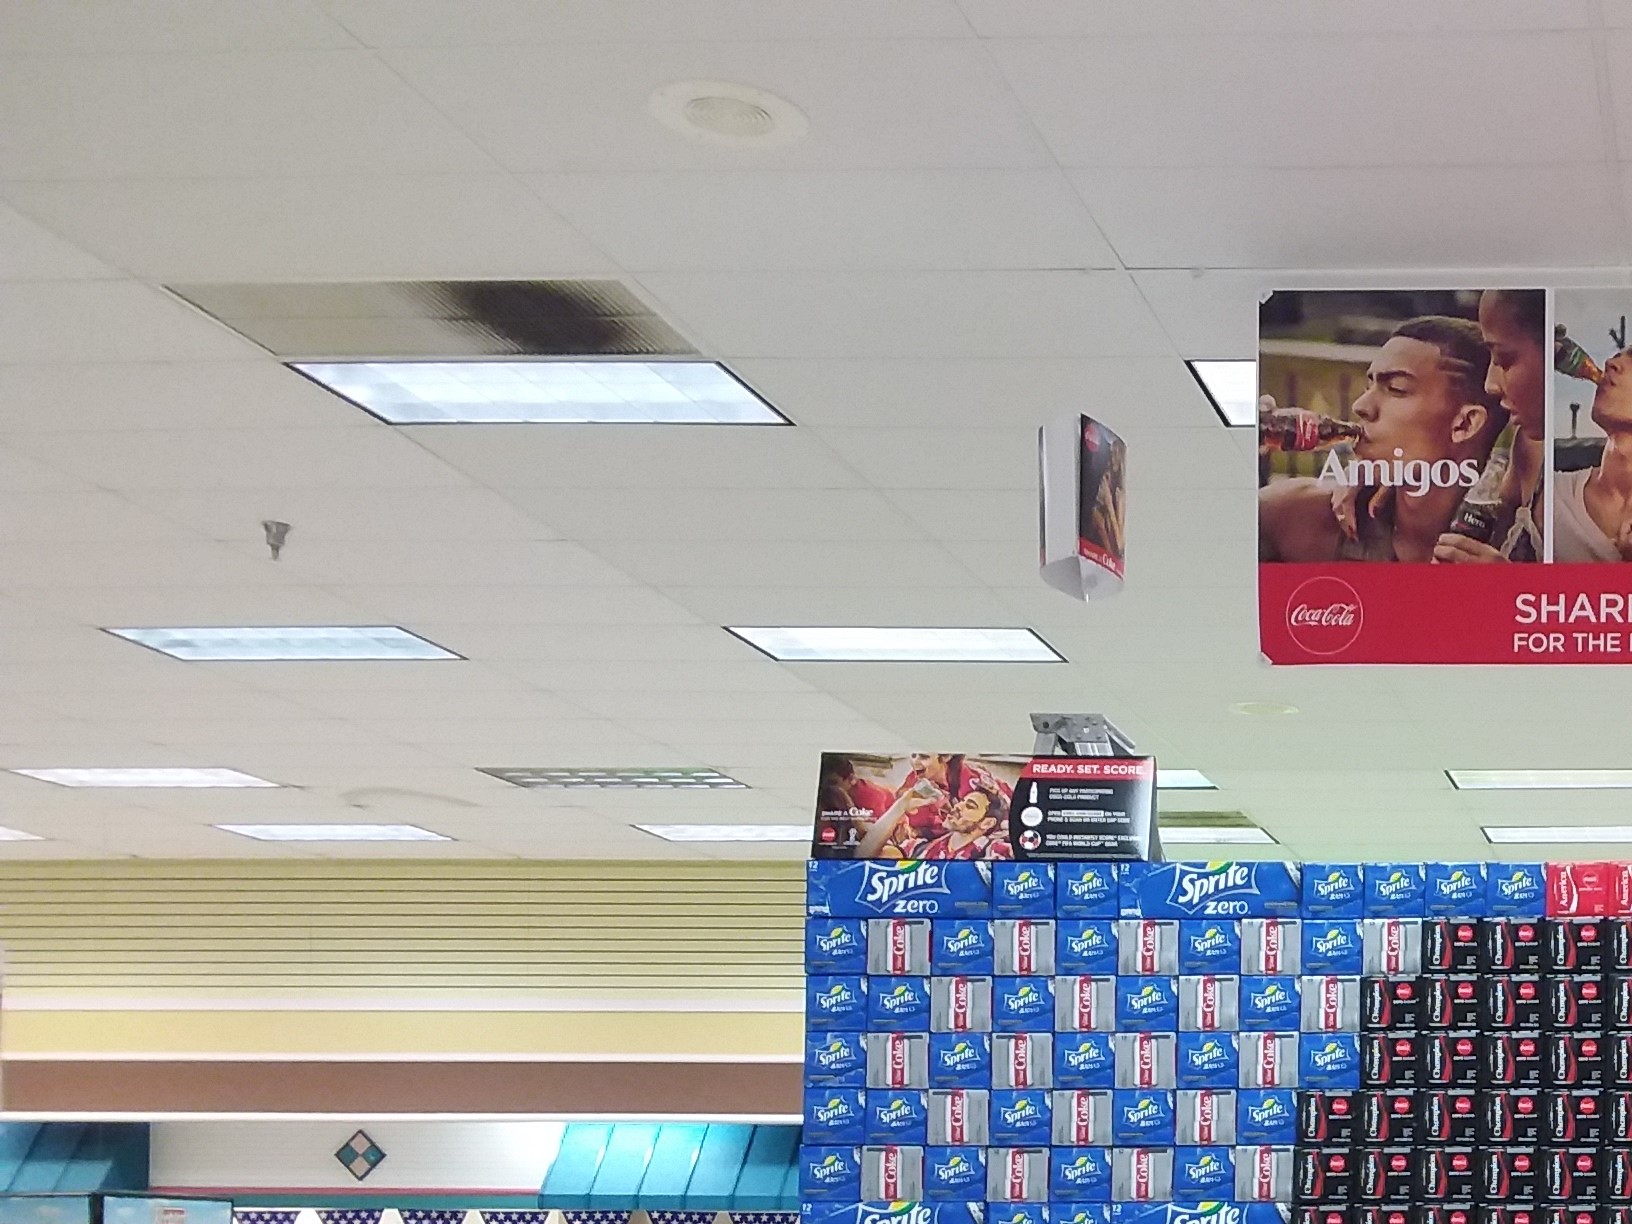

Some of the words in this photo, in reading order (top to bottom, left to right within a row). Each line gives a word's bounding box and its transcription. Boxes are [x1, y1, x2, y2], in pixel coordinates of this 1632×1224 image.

[1318, 448, 1480, 497] Amigos
[1290, 604, 1357, 627] Coca-Cola
[1514, 633, 1564, 652] FOR
[1570, 633, 1622, 652] THE
[1032, 763, 1074, 774] READY.
[1077, 764, 1100, 774] SET.
[866, 860, 939, 902] Sprite
[1177, 862, 1249, 904] Sprite
[893, 899, 939, 913] zero
[1205, 900, 1248, 915] zero
